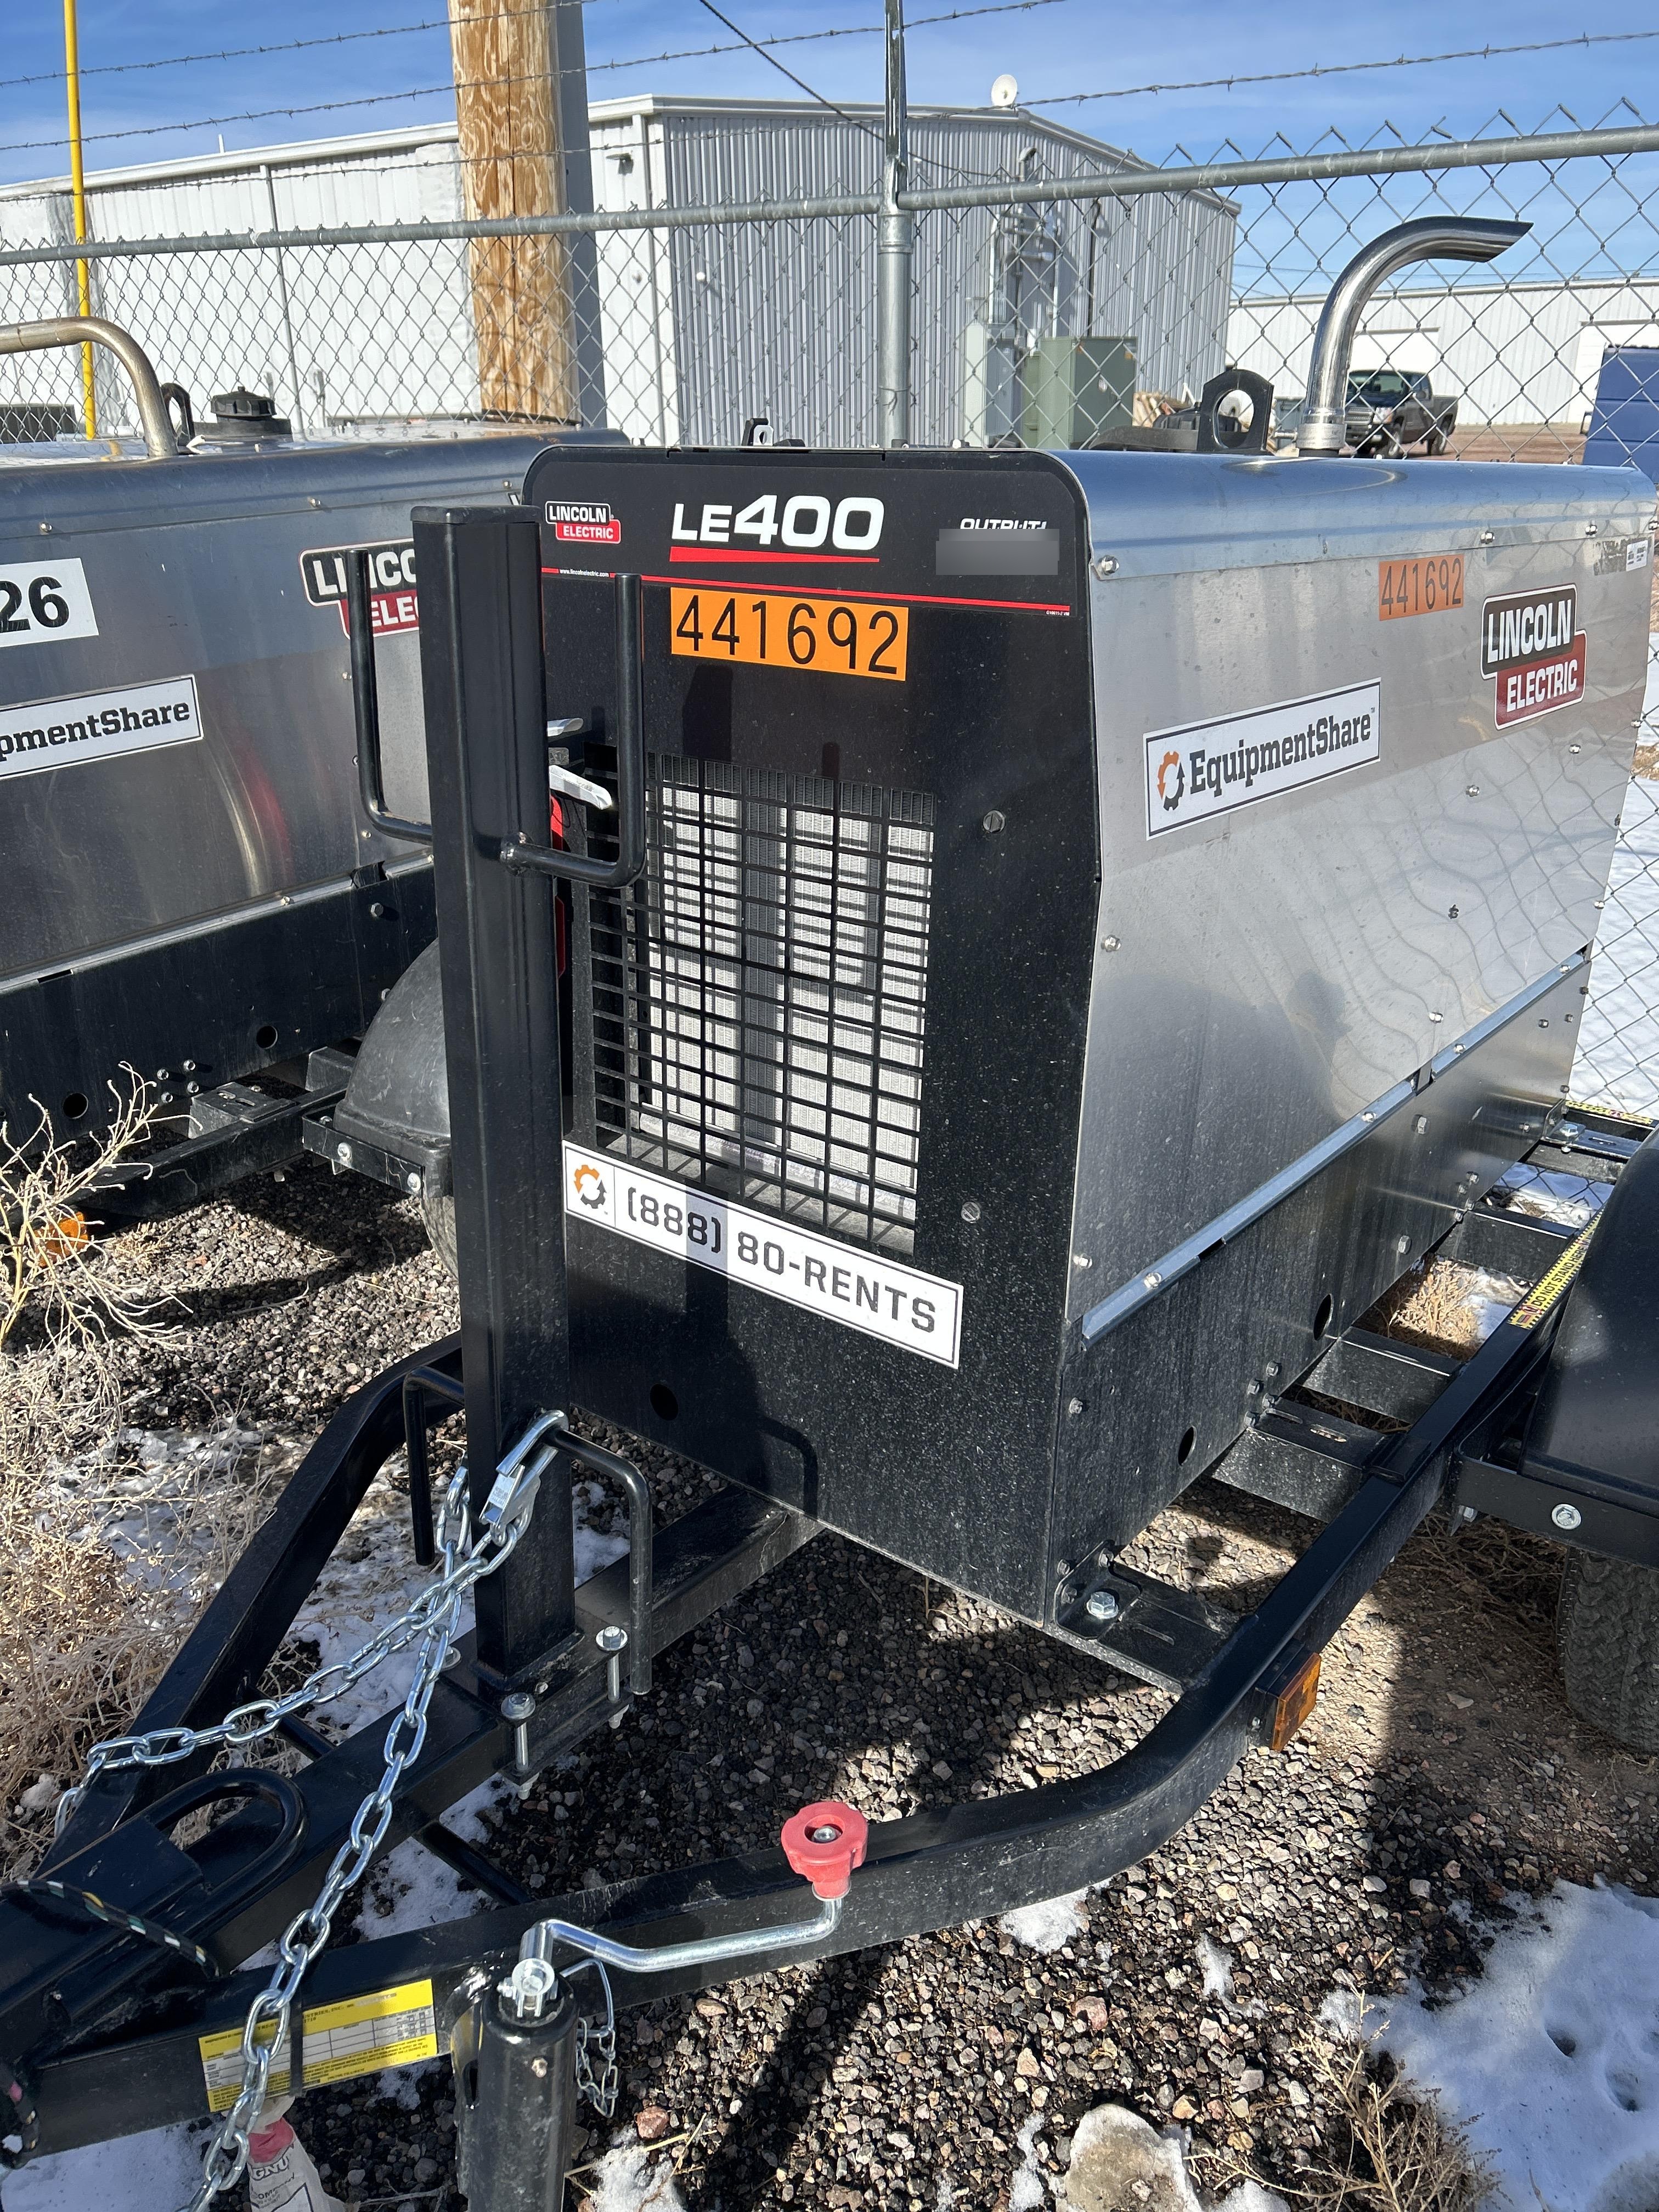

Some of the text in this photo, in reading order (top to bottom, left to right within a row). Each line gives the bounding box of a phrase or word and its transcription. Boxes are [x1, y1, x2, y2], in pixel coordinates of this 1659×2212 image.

[549, 505, 606, 523] LINCOLN
[563, 525, 614, 539] ELECTRIC
[672, 495, 884, 550] LE400
[312, 549, 416, 595] LICO
[560, 568, 610, 577] www.lincolnelectric.com
[1381, 558, 1462, 615] 441692
[676, 595, 899, 675] 441692
[1487, 599, 1571, 663] LINCOLN
[1506, 659, 1578, 713] ELECTRIC
[1189, 713, 1371, 798] EquipmentShare
[628, 1186, 936, 1333] (888) 80-RENTS
[1531, 1295, 1547, 1306] DO
[1540, 1282, 1558, 1296] NOT
[1551, 1262, 1575, 1283] STAND
